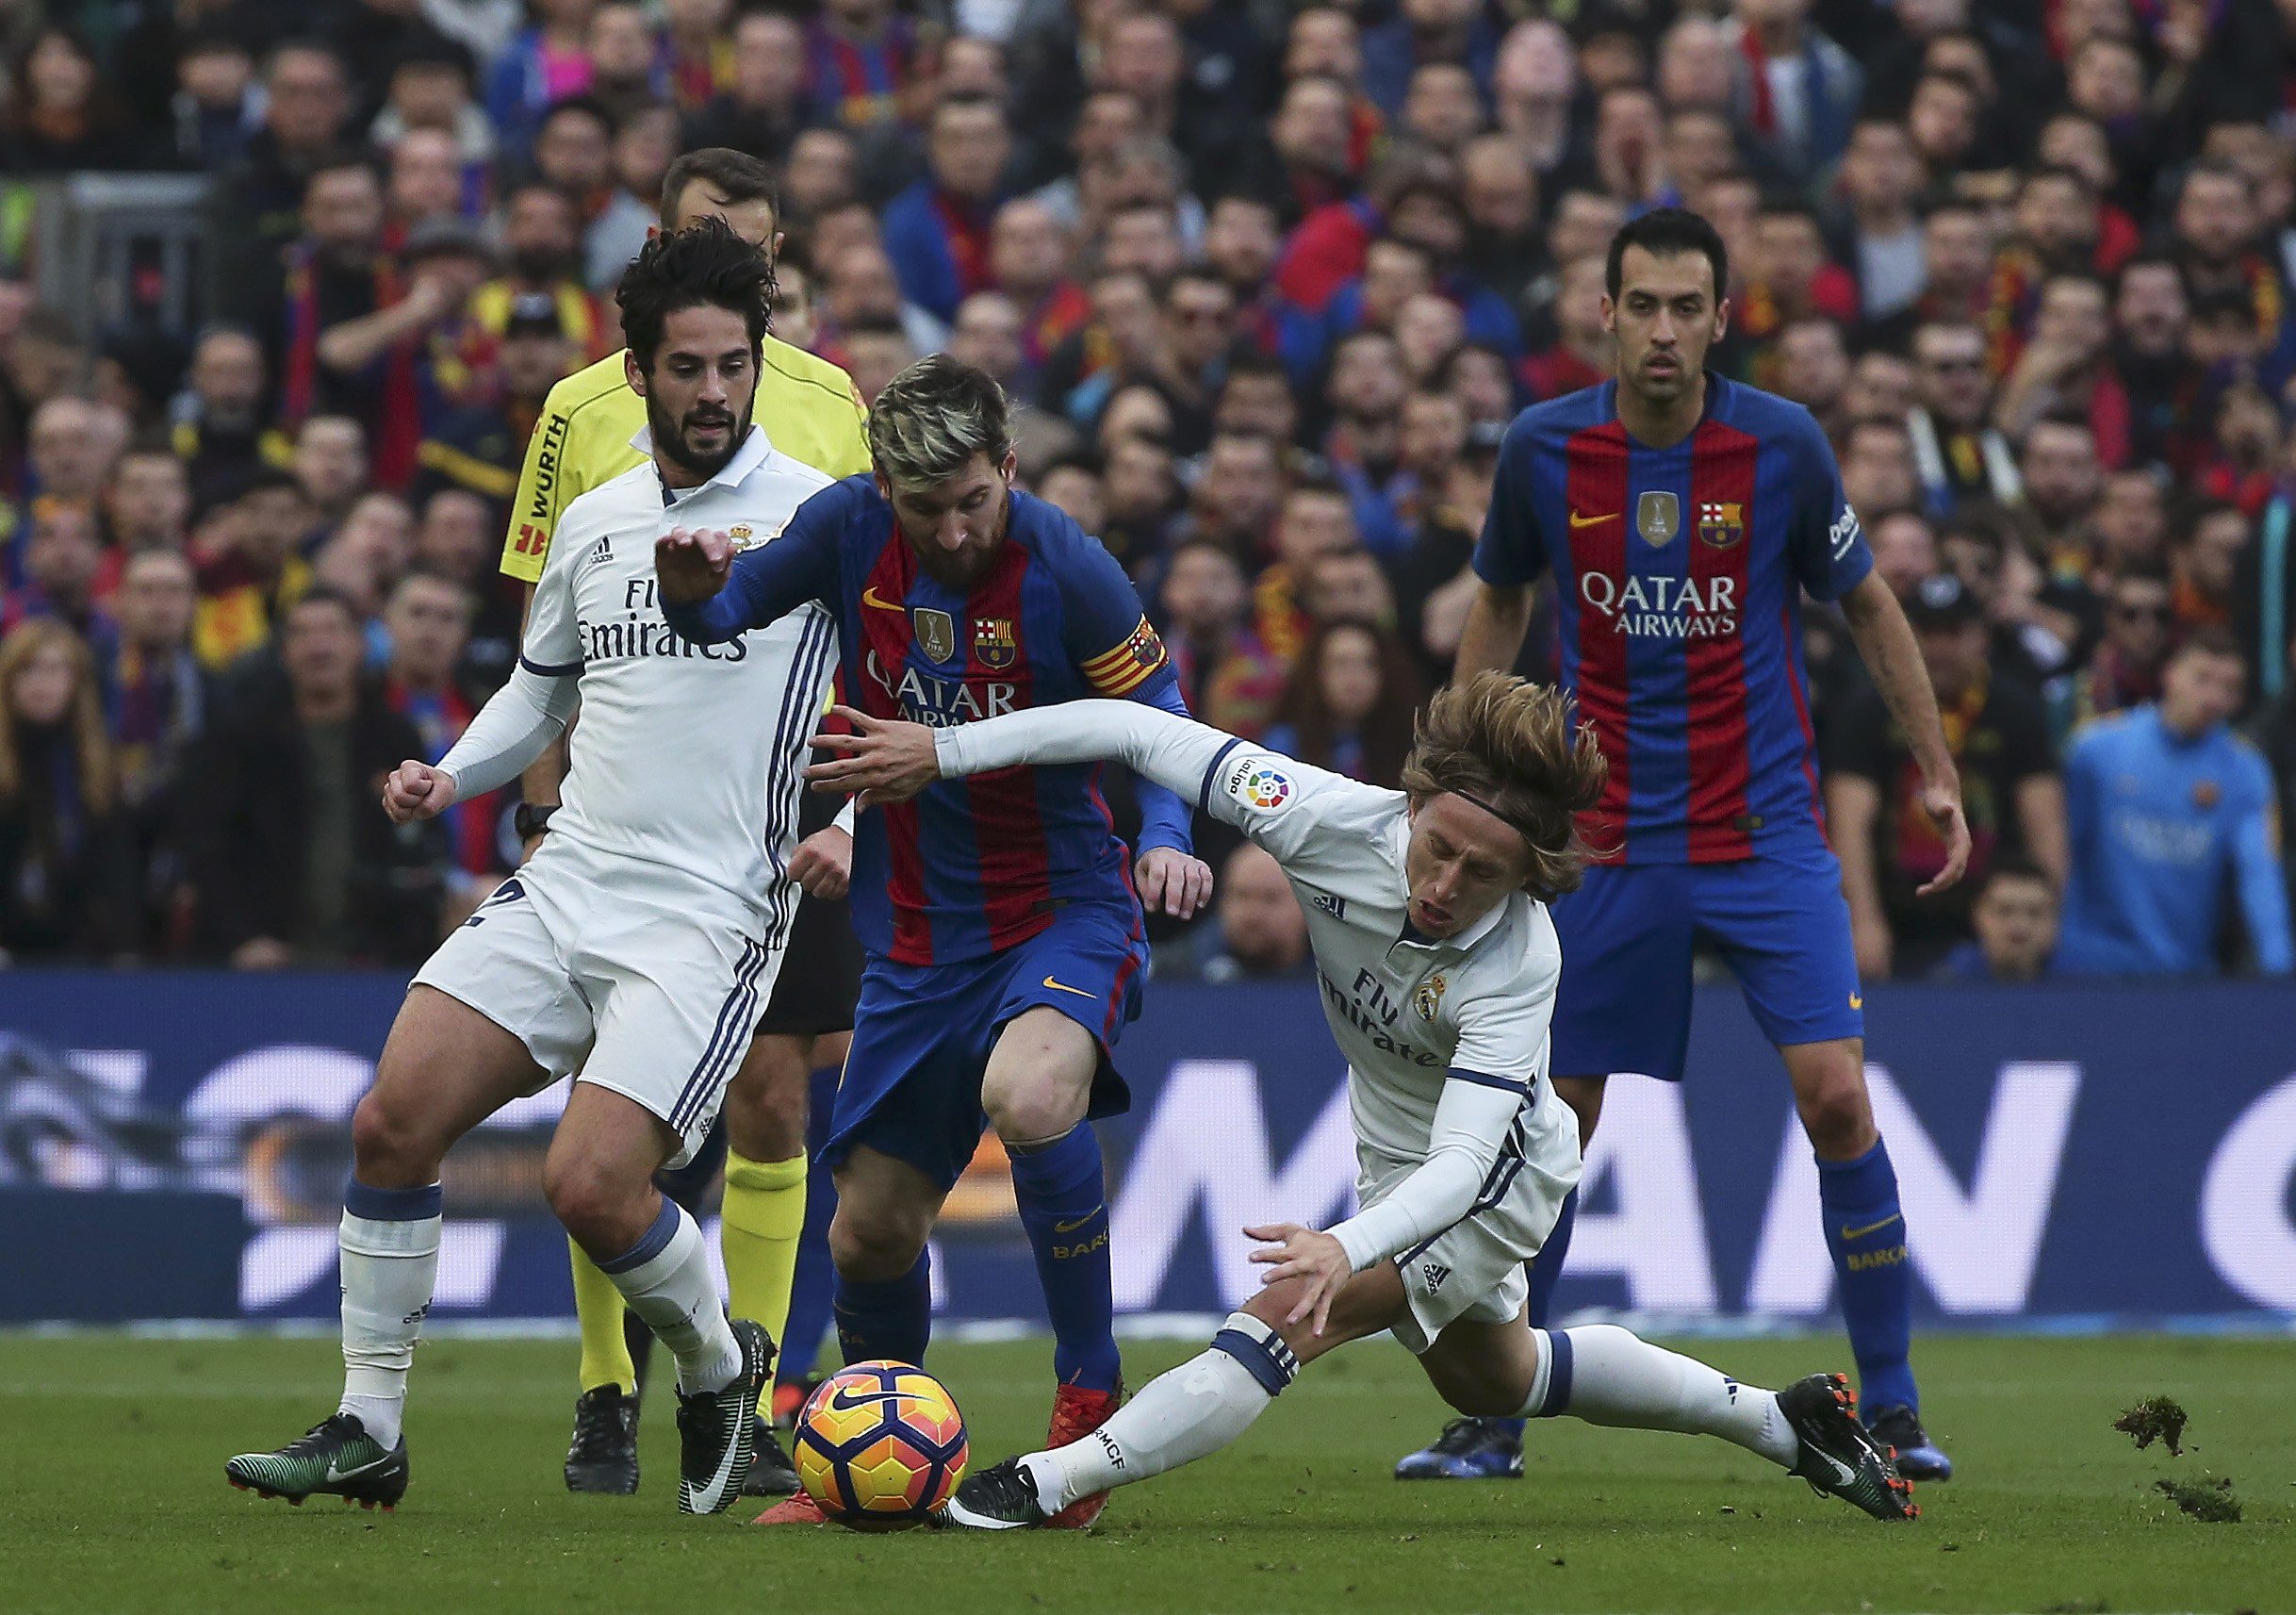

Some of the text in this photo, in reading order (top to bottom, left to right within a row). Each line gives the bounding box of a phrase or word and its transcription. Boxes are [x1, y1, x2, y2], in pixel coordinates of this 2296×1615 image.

[625, 579, 654, 608] Fl
[1582, 571, 1736, 616] QATAR
[1614, 613, 1735, 638] AIRWAYS
[866, 649, 1017, 719] QATAR
[1320, 968, 1448, 1069] mirate
[1353, 966, 1400, 1027] Fly
